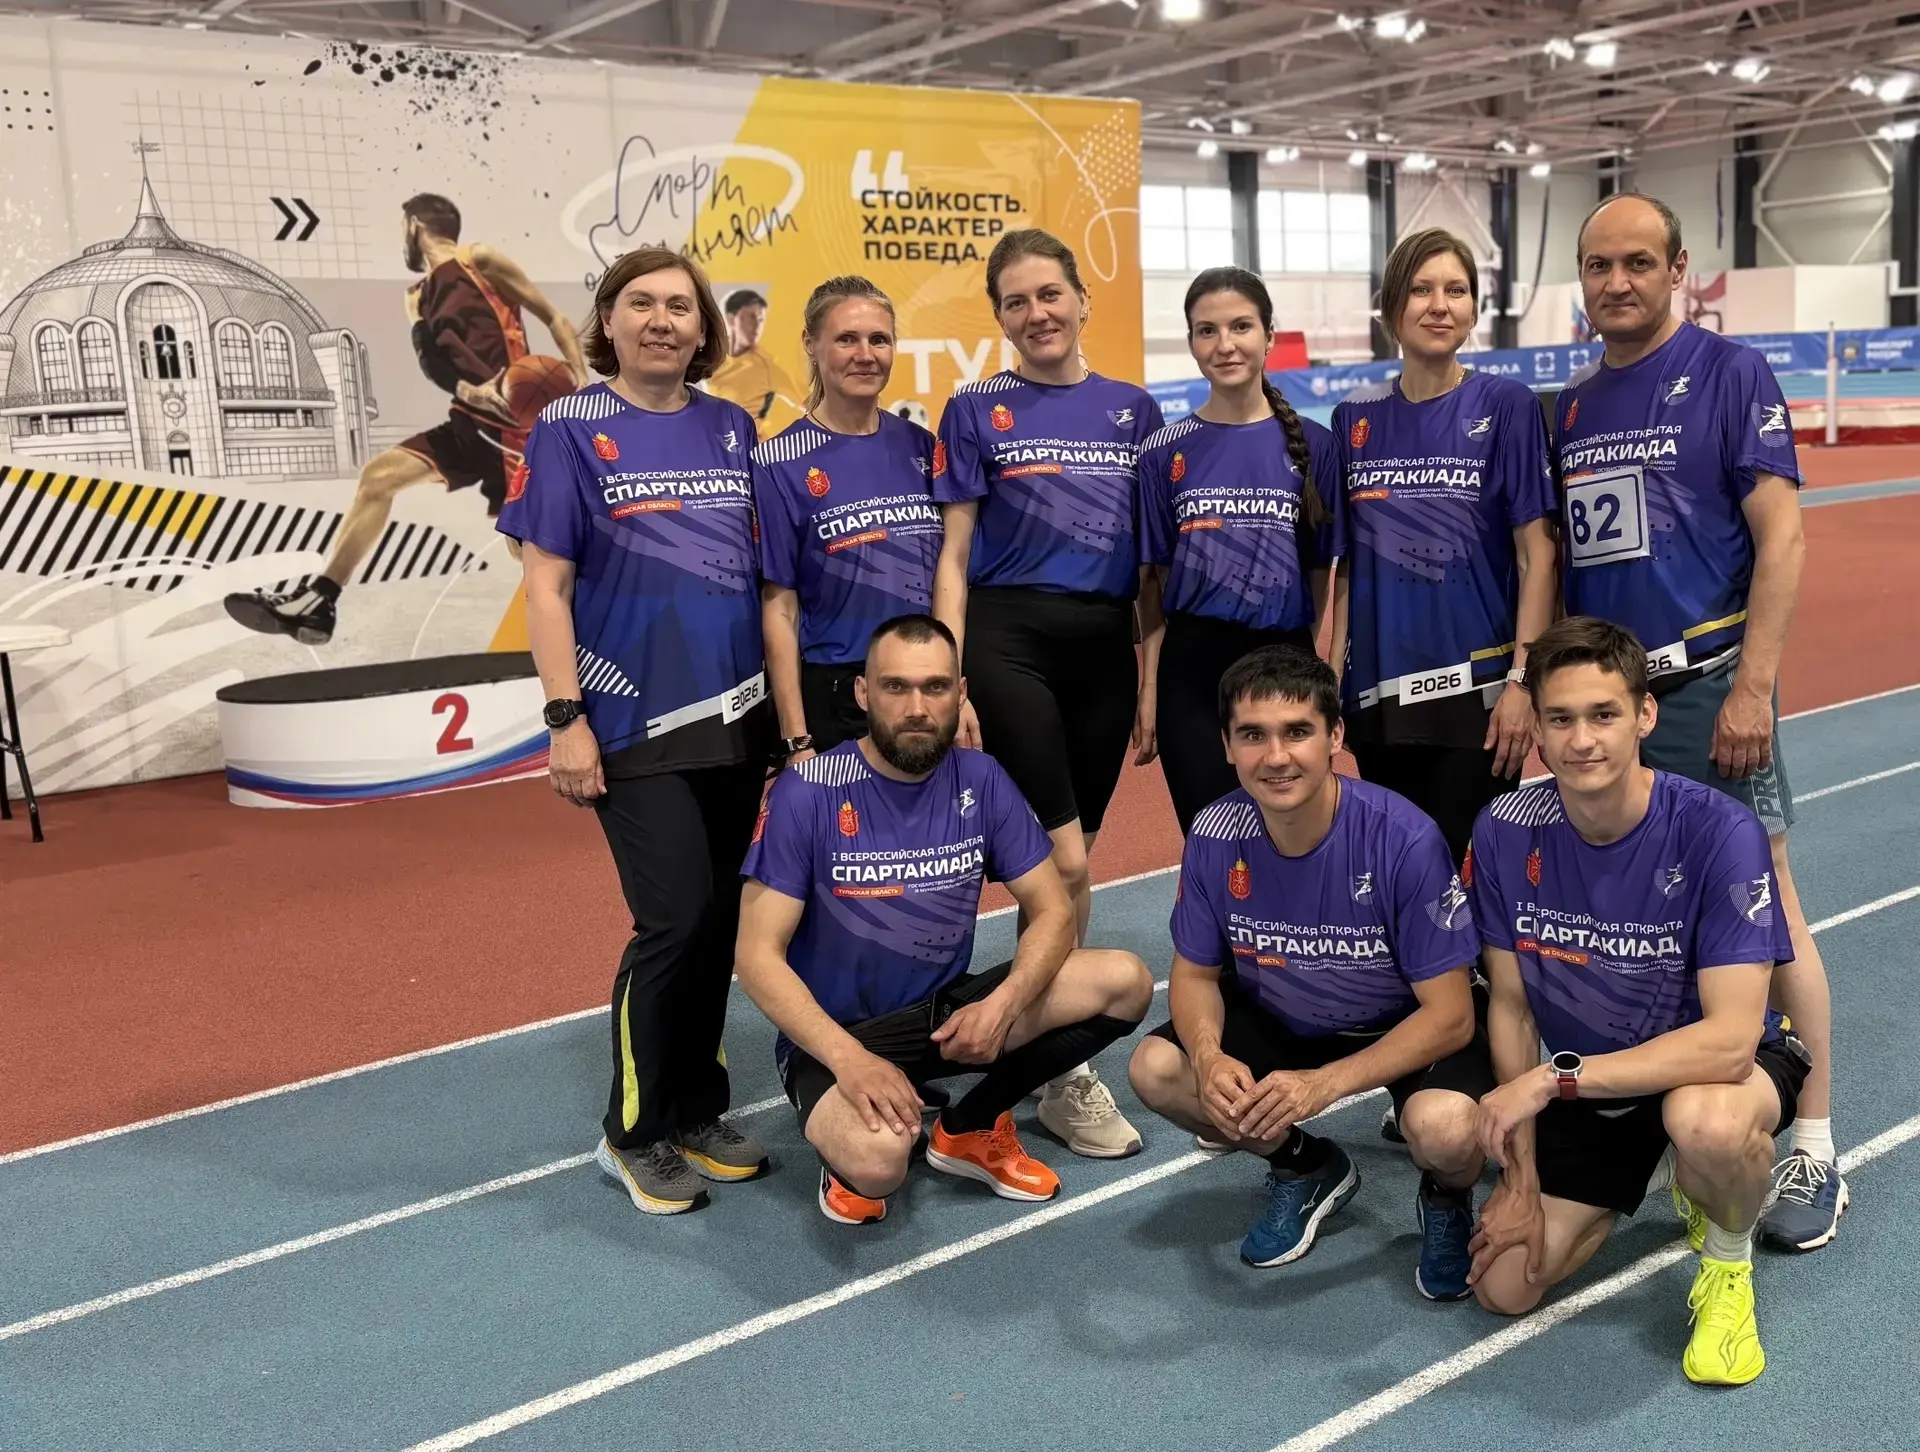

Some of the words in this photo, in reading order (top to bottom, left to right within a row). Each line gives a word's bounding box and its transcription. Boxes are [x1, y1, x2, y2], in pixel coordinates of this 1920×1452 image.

[861, 186, 1027, 213] СТОЙКОСТЬ.
[862, 215, 1004, 237] ХАРАКТЕР
[864, 241, 986, 265] ПОБЕДА.
[998, 438, 1088, 451] ВСЕРОССИЙСКАЯ
[1427, 456, 1486, 469] ОТКРЫТАЯ
[597, 477, 604, 486] I
[606, 469, 706, 484] ВСЕРОССИЙСКАЯ
[614, 504, 647, 517] ТУЛЬСКАЯ
[647, 502, 676, 510] ОБЛАСТЬ
[811, 514, 819, 523] I
[819, 494, 906, 521] ВСЕРОССИЙСКАЯ
[1570, 493, 1623, 546] 82
[1410, 671, 1462, 696] 2026
[731, 681, 759, 713] 2026
[430, 692, 474, 755] 2
[831, 852, 837, 861] I
[840, 847, 935, 862] ВСЕРОССИЙСКАЯ
[937, 834, 984, 855] ОТКРЫТАЯ
[831, 848, 984, 882] СПАРТАКИАДА
[838, 888, 870, 896] ТУЛЬСКАЯ
[870, 888, 899, 896] ОБЛАСТЬ
[1516, 901, 1523, 911] I
[1320, 924, 1385, 937] ОТКРЫТАЯ
[1551, 949, 1581, 962] ОБЛАСТЬ
